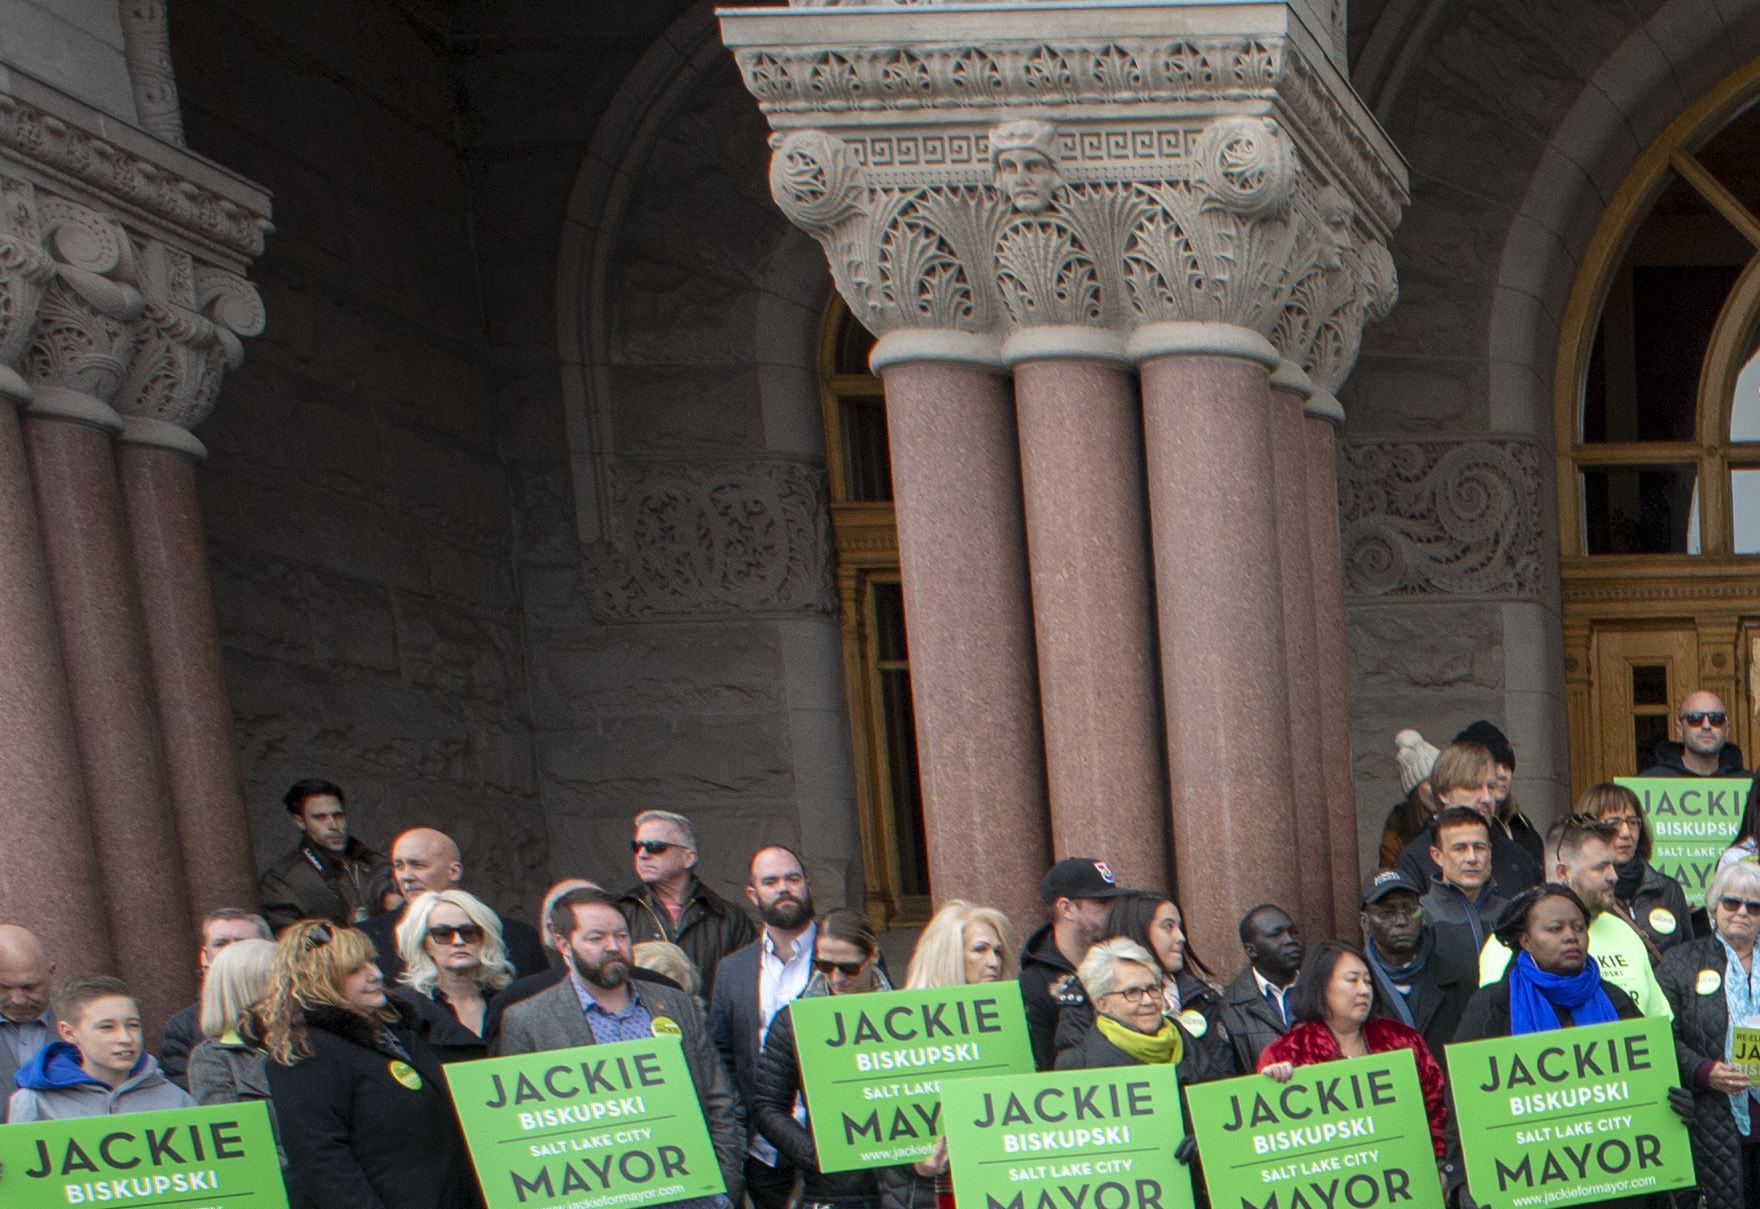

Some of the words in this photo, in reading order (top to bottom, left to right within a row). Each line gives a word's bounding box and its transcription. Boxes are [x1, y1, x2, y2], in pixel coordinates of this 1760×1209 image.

[1642, 790, 1751, 816] JACKI
[1656, 822, 1738, 836] BISKUPSK
[1657, 848, 1683, 857] SALT
[1687, 848, 1715, 857] LAKE
[825, 998, 1001, 1047] JACKIE
[856, 1043, 980, 1071] BISKUPSKI
[1480, 1035, 1651, 1092] JACKIE
[485, 1053, 665, 1109] JACKIE
[863, 1084, 900, 1100] SALT
[518, 1096, 646, 1130] BISKUPSKI
[973, 1082, 1154, 1128] JACKIE
[1223, 1069, 1396, 1132] JACKIE
[1509, 1081, 1629, 1116] BISKUPSKI
[841, 1102, 941, 1146] MAY
[1003, 1126, 1130, 1153] BISKUPSKI
[1253, 1117, 1375, 1154] BISKUPSKI
[1516, 1128, 1551, 1144] SALT
[1556, 1122, 1594, 1139] LAKE
[1597, 1115, 1632, 1132] CITY
[25, 1121, 246, 1178] JACKIE
[529, 1140, 568, 1157] SALT
[571, 1134, 613, 1151] LAKE
[616, 1128, 653, 1144] CITY
[510, 1146, 691, 1202] MAYOR
[1009, 1167, 1047, 1181] SALT
[1051, 1164, 1092, 1178] LAKE
[1096, 1159, 1132, 1174] CITY
[1261, 1165, 1298, 1182] SALT
[1301, 1158, 1341, 1175] LAKE
[1344, 1150, 1380, 1167] CITY
[1494, 1134, 1663, 1191] MAYOR
[64, 1170, 219, 1204] BISKUPSKI
[1512, 1176, 1656, 1207] www.jackieformayor.com
